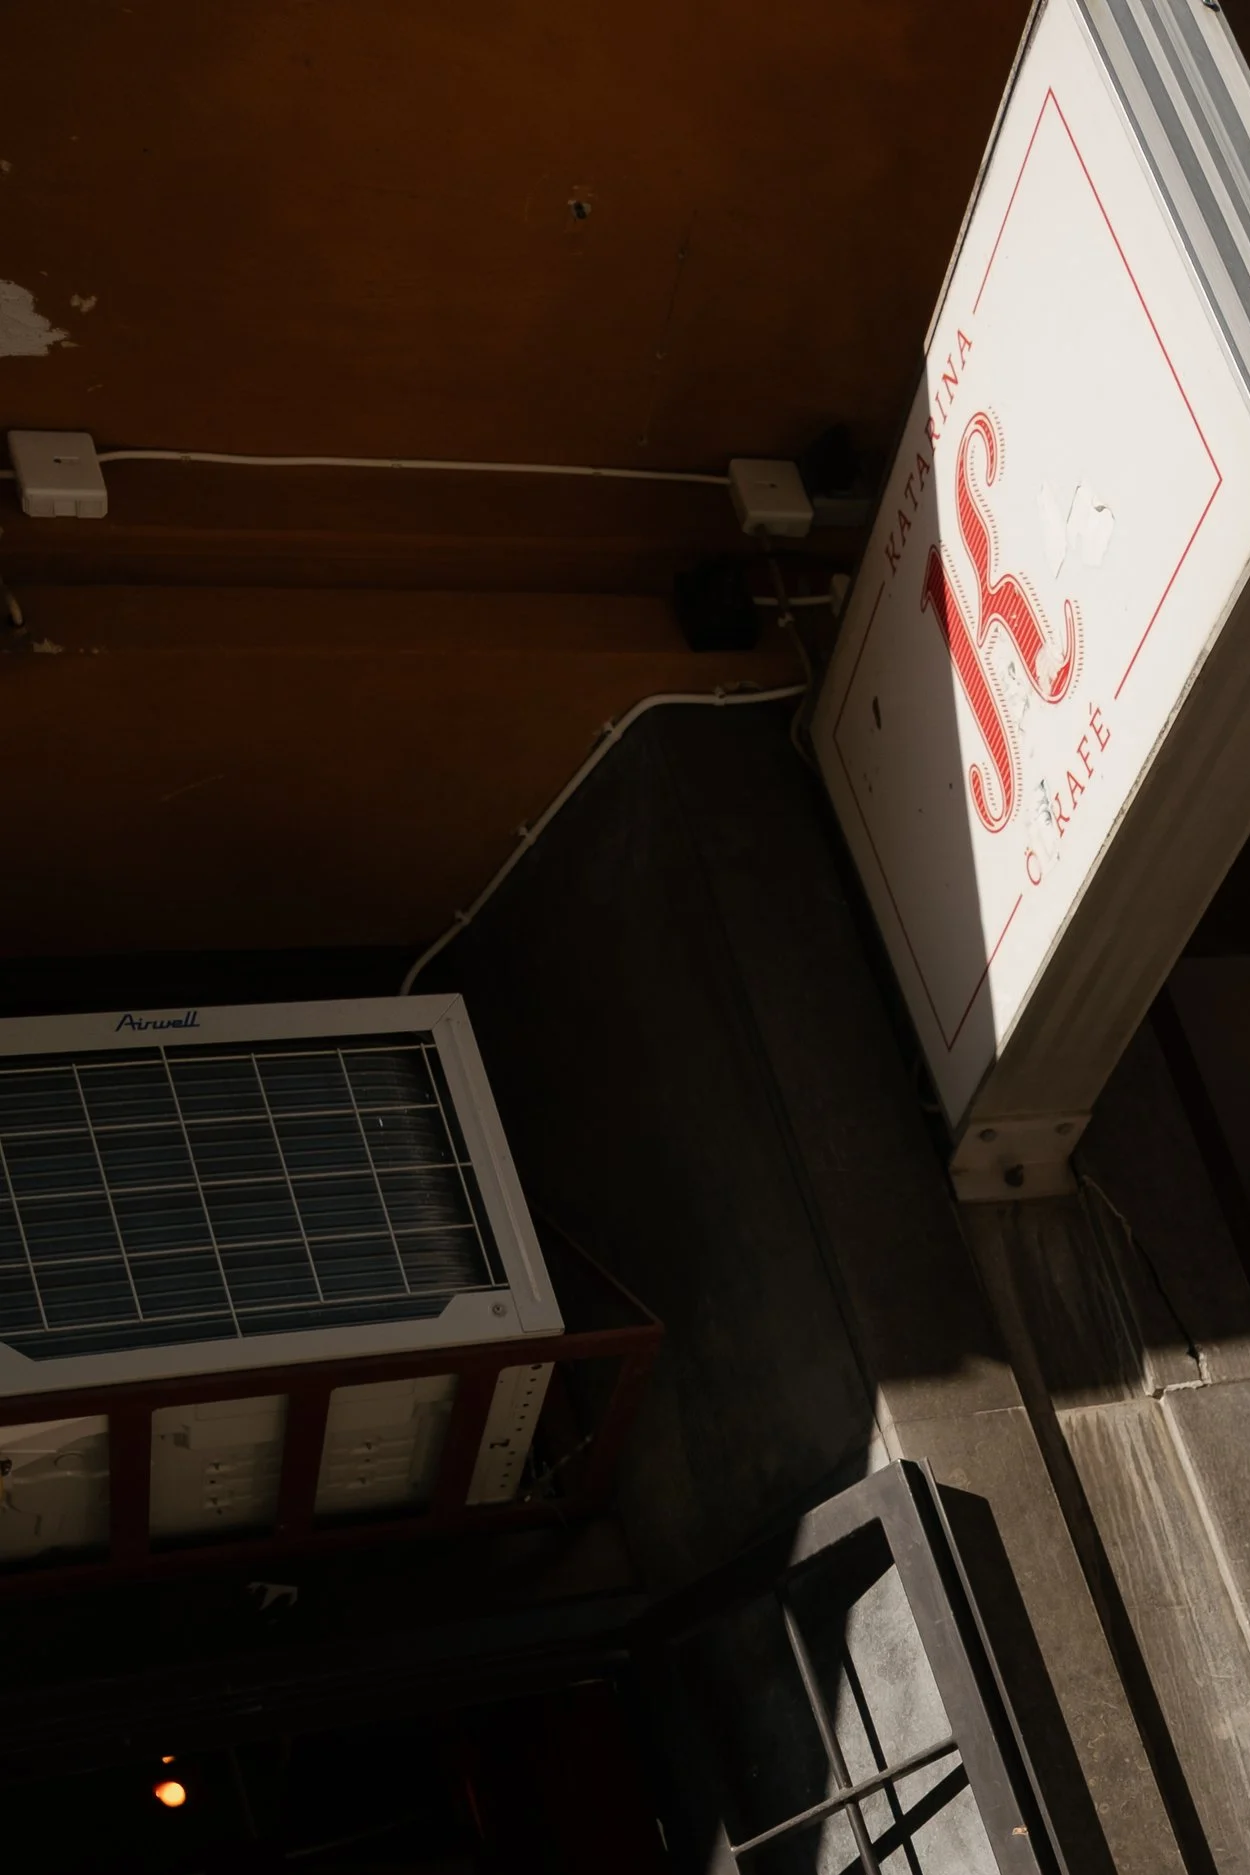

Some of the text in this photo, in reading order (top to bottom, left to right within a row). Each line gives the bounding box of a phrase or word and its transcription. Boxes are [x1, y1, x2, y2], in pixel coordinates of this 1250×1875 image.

[885, 327, 974, 577] KATARINA
[1024, 702, 1111, 886] ÖKAFÉ
[116, 1010, 200, 1032] Airwell
